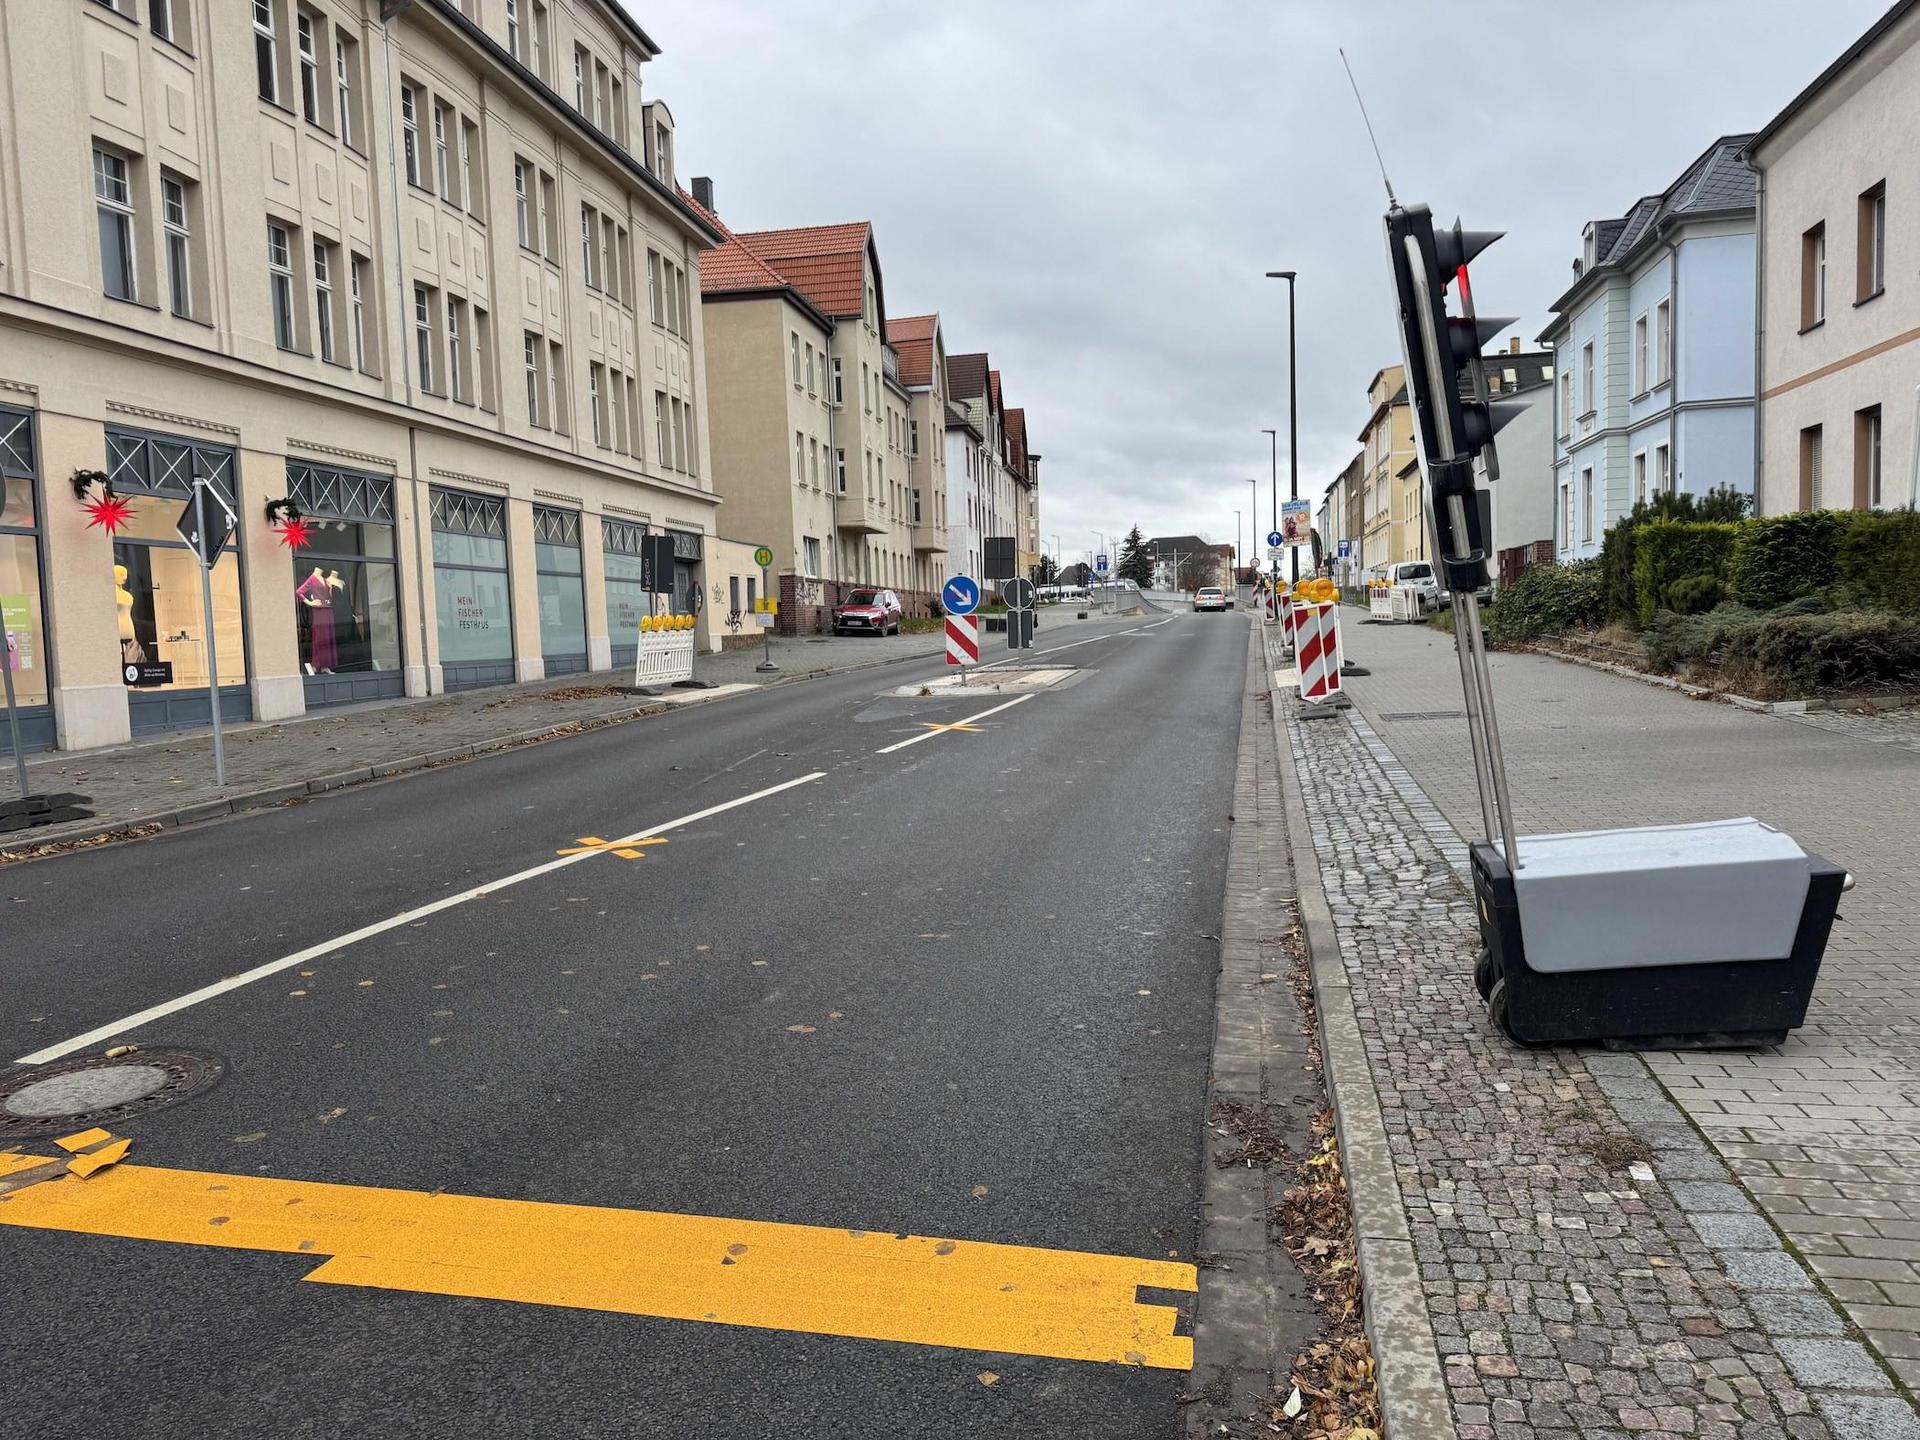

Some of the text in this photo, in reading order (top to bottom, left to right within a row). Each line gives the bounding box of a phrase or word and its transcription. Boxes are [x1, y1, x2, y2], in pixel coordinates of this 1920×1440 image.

[760, 551, 768, 562] H
[458, 608, 483, 617] FISCHER
[459, 620, 489, 629] FESTHAUS
